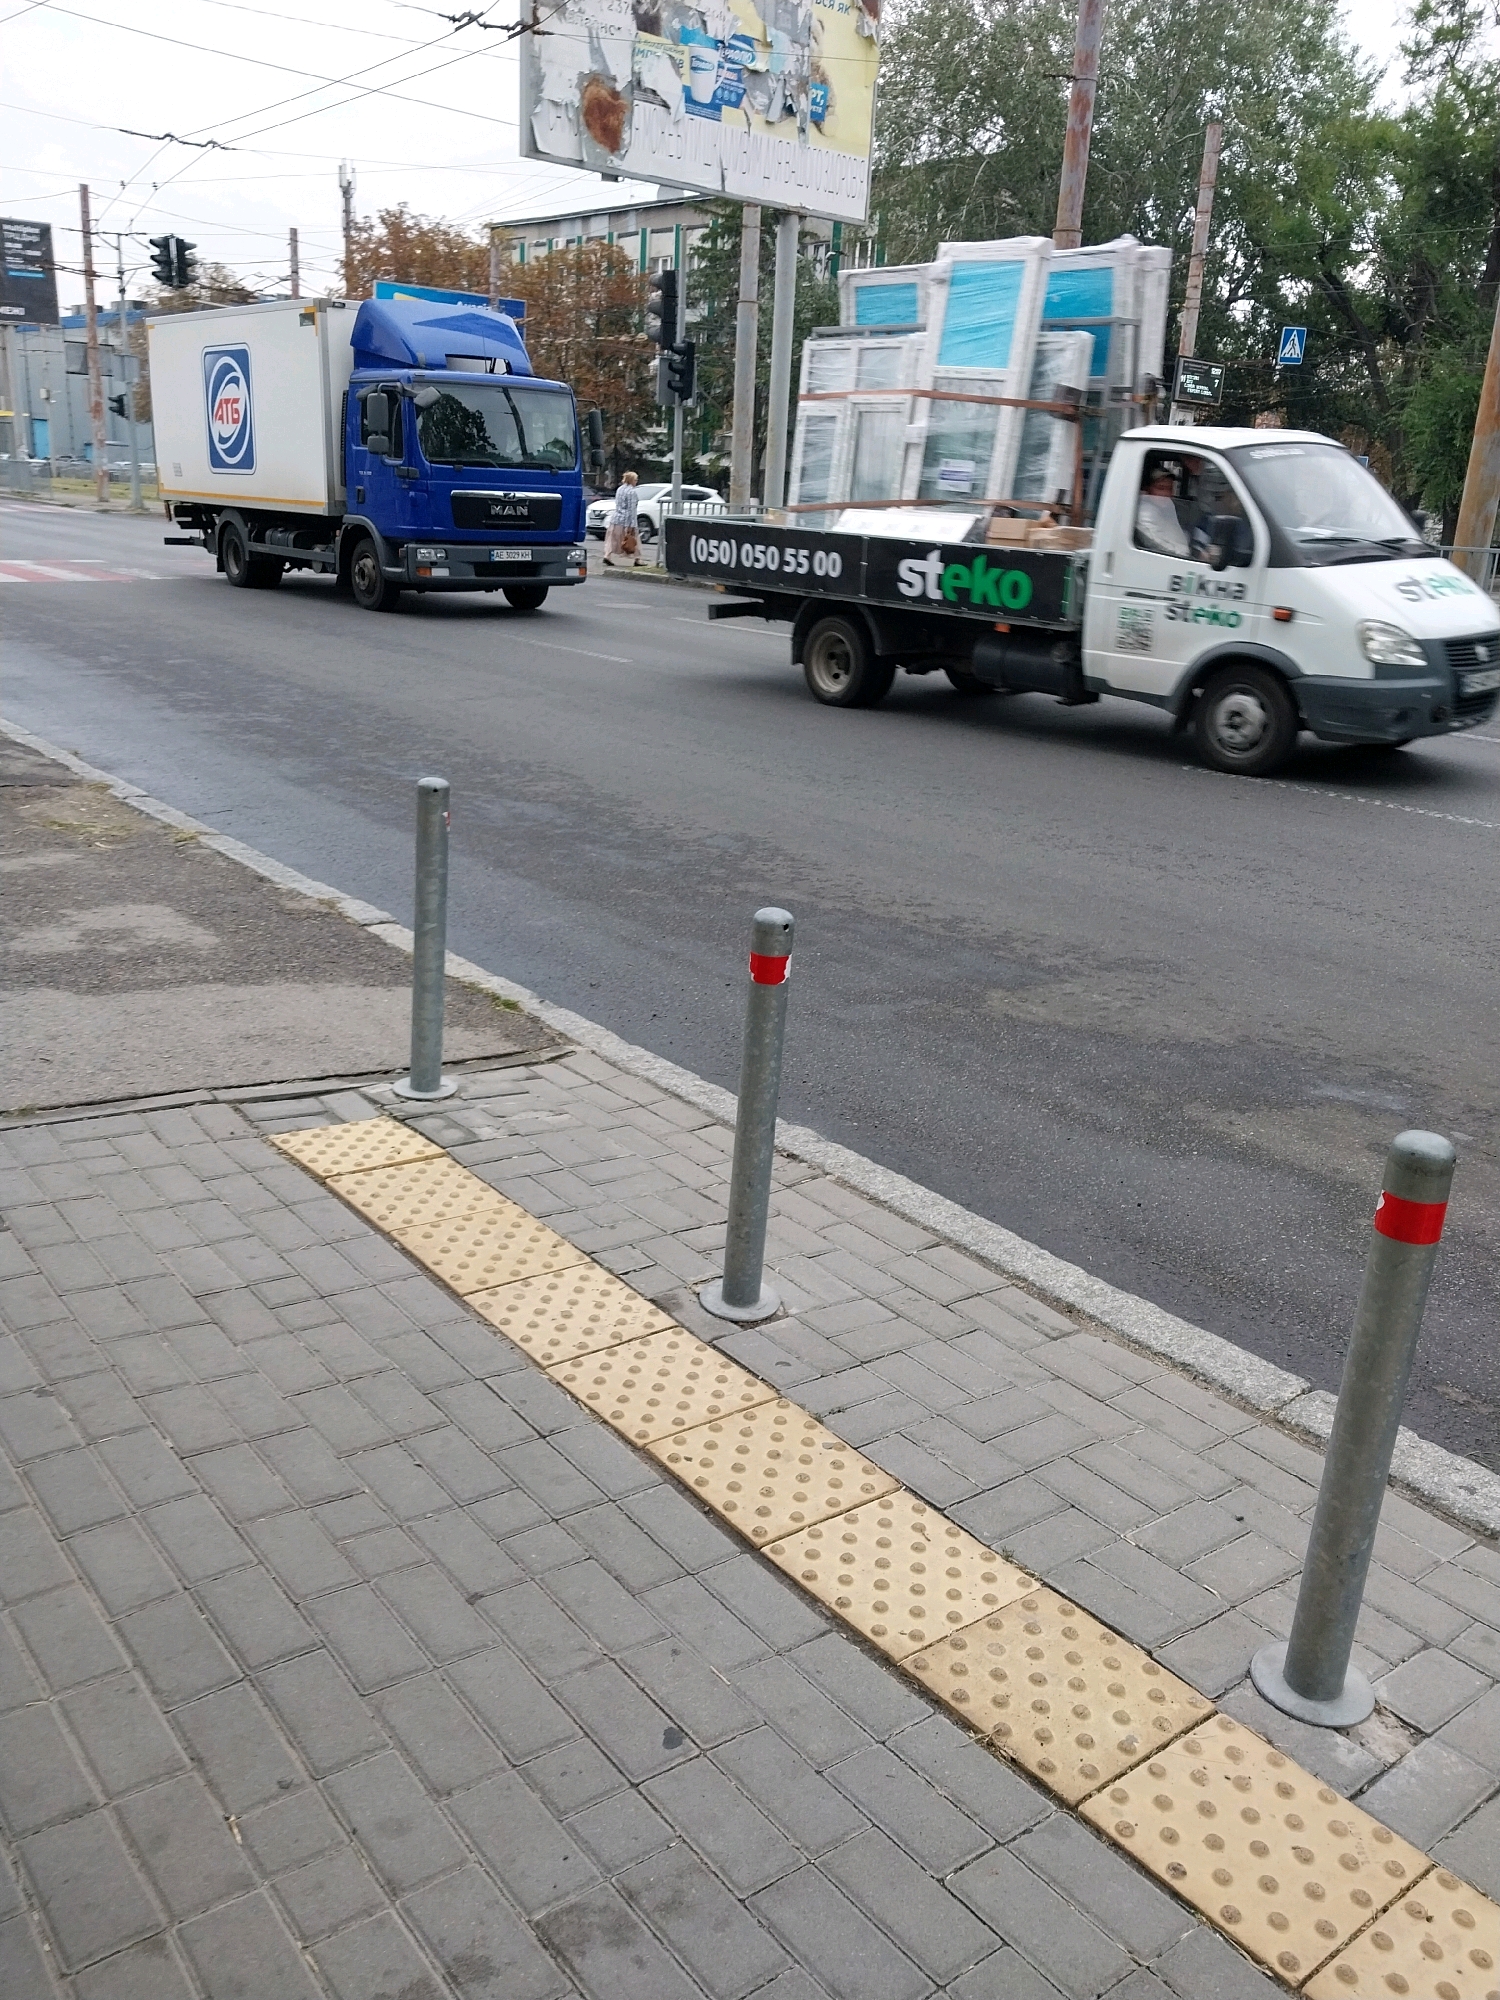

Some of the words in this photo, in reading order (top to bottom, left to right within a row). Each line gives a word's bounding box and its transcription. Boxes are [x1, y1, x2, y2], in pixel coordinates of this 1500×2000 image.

[837, 2, 850, 15] ЯК
[214, 397, 241, 425] АТБ
[490, 504, 529, 516] MAN
[689, 534, 738, 569] (050)
[740, 542, 780, 571] 050
[782, 547, 810, 575] 55
[812, 550, 843, 578] 00
[896, 549, 1033, 610] steko
[1167, 571, 1248, 600] вікна
[1394, 572, 1475, 603] steko
[1164, 600, 1243, 629] steko
